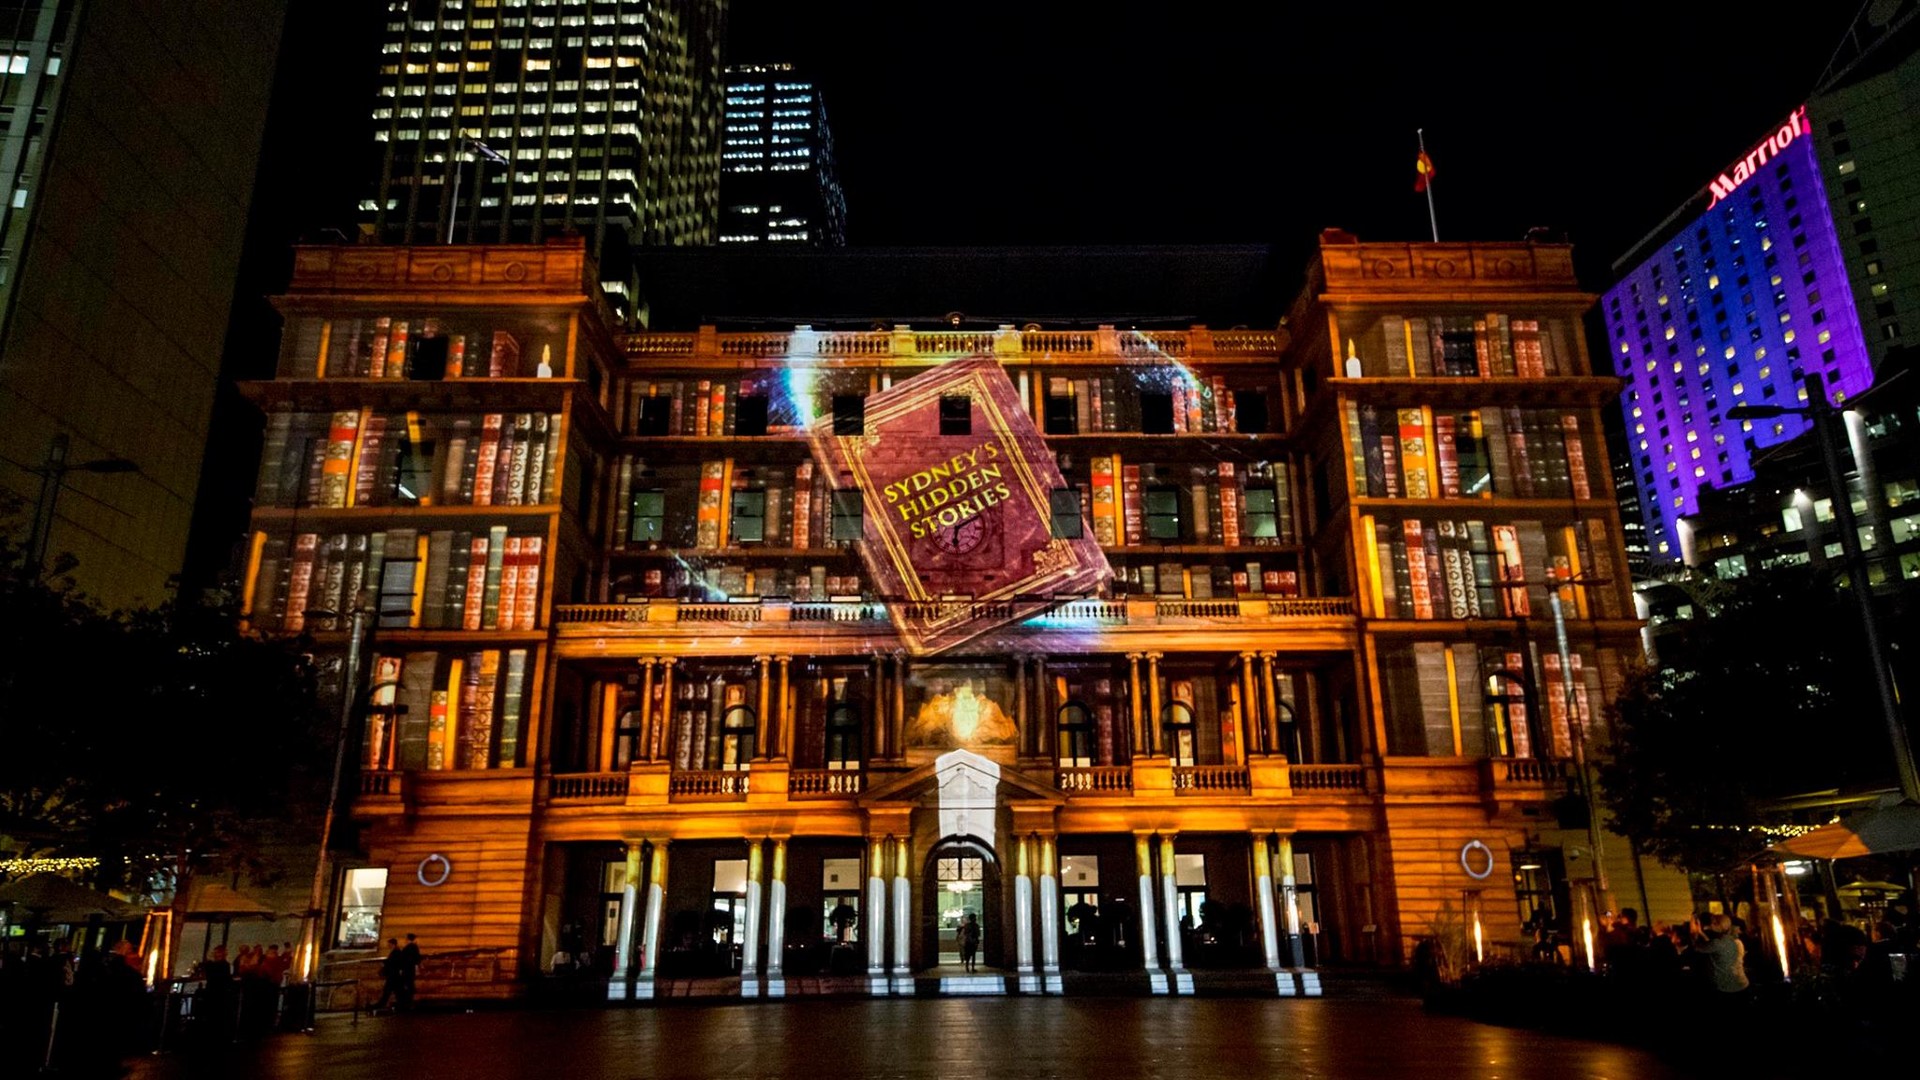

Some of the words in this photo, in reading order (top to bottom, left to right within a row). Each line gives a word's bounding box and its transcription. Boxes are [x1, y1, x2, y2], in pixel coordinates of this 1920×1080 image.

[883, 441, 998, 503] SYDNEY'S
[898, 462, 1002, 521] HIDDEN
[910, 482, 1011, 539] STORIES
